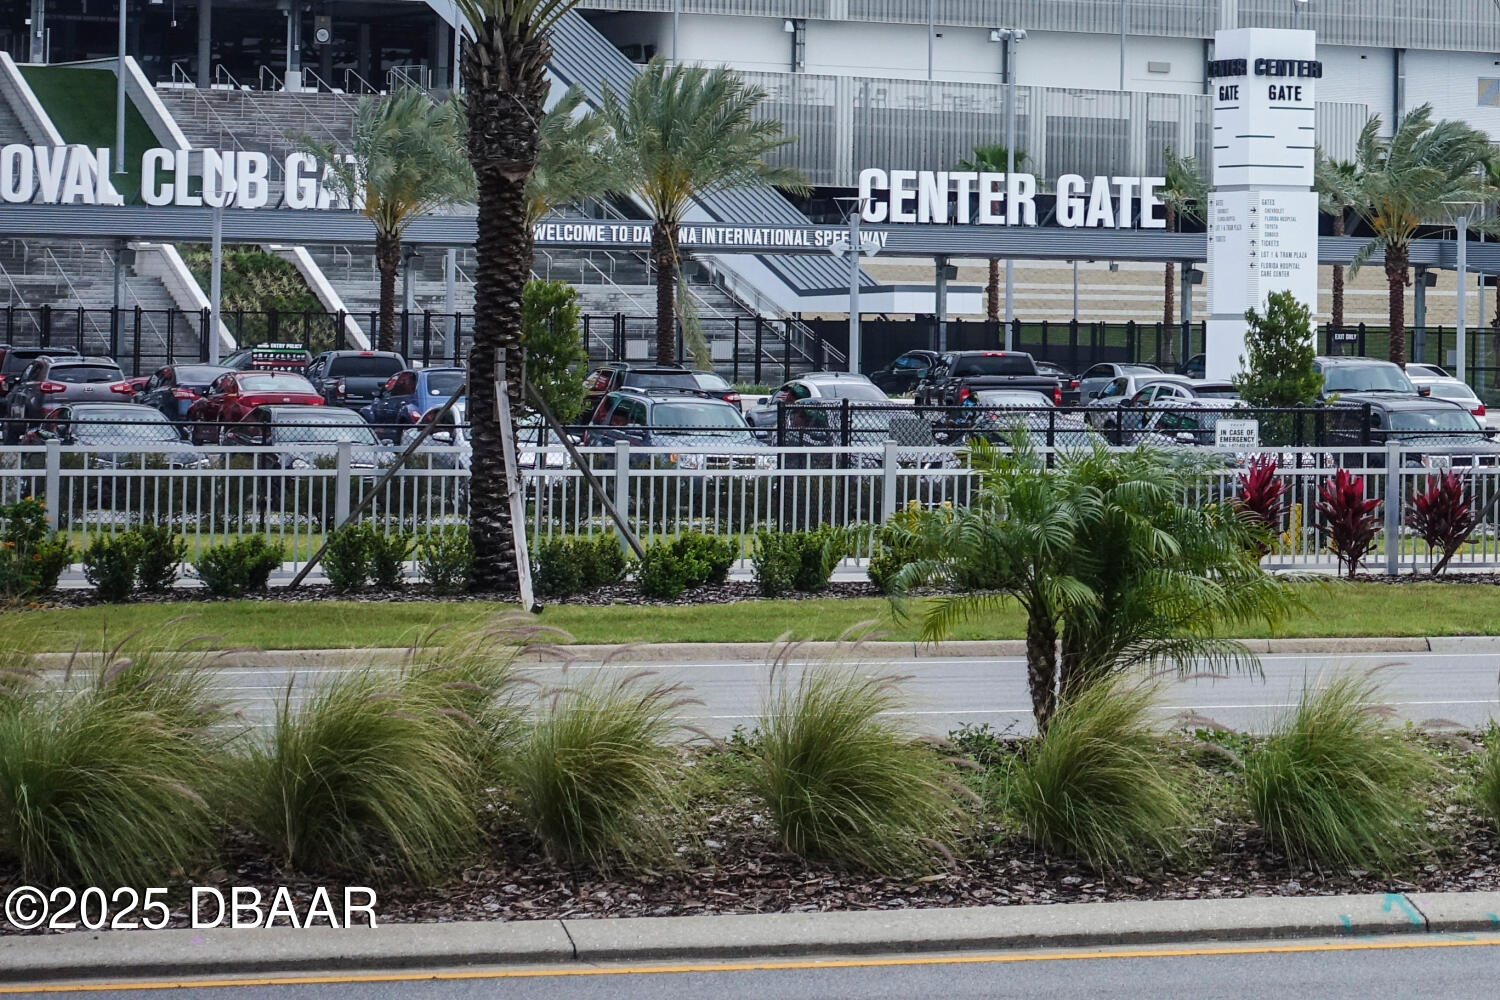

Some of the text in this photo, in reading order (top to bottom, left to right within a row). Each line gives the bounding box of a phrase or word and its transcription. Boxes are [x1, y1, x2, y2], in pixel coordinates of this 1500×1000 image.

[1254, 58, 1322, 78] CENTER
[1219, 85, 1239, 101] GATE
[1268, 85, 1302, 101] GATE
[0, 144, 370, 210] OVAL CLUB GAT
[858, 168, 1167, 229] CENTER GATE
[533, 223, 889, 248] WELCOME TO DANA INTERNATIONAL SPEEWAY
